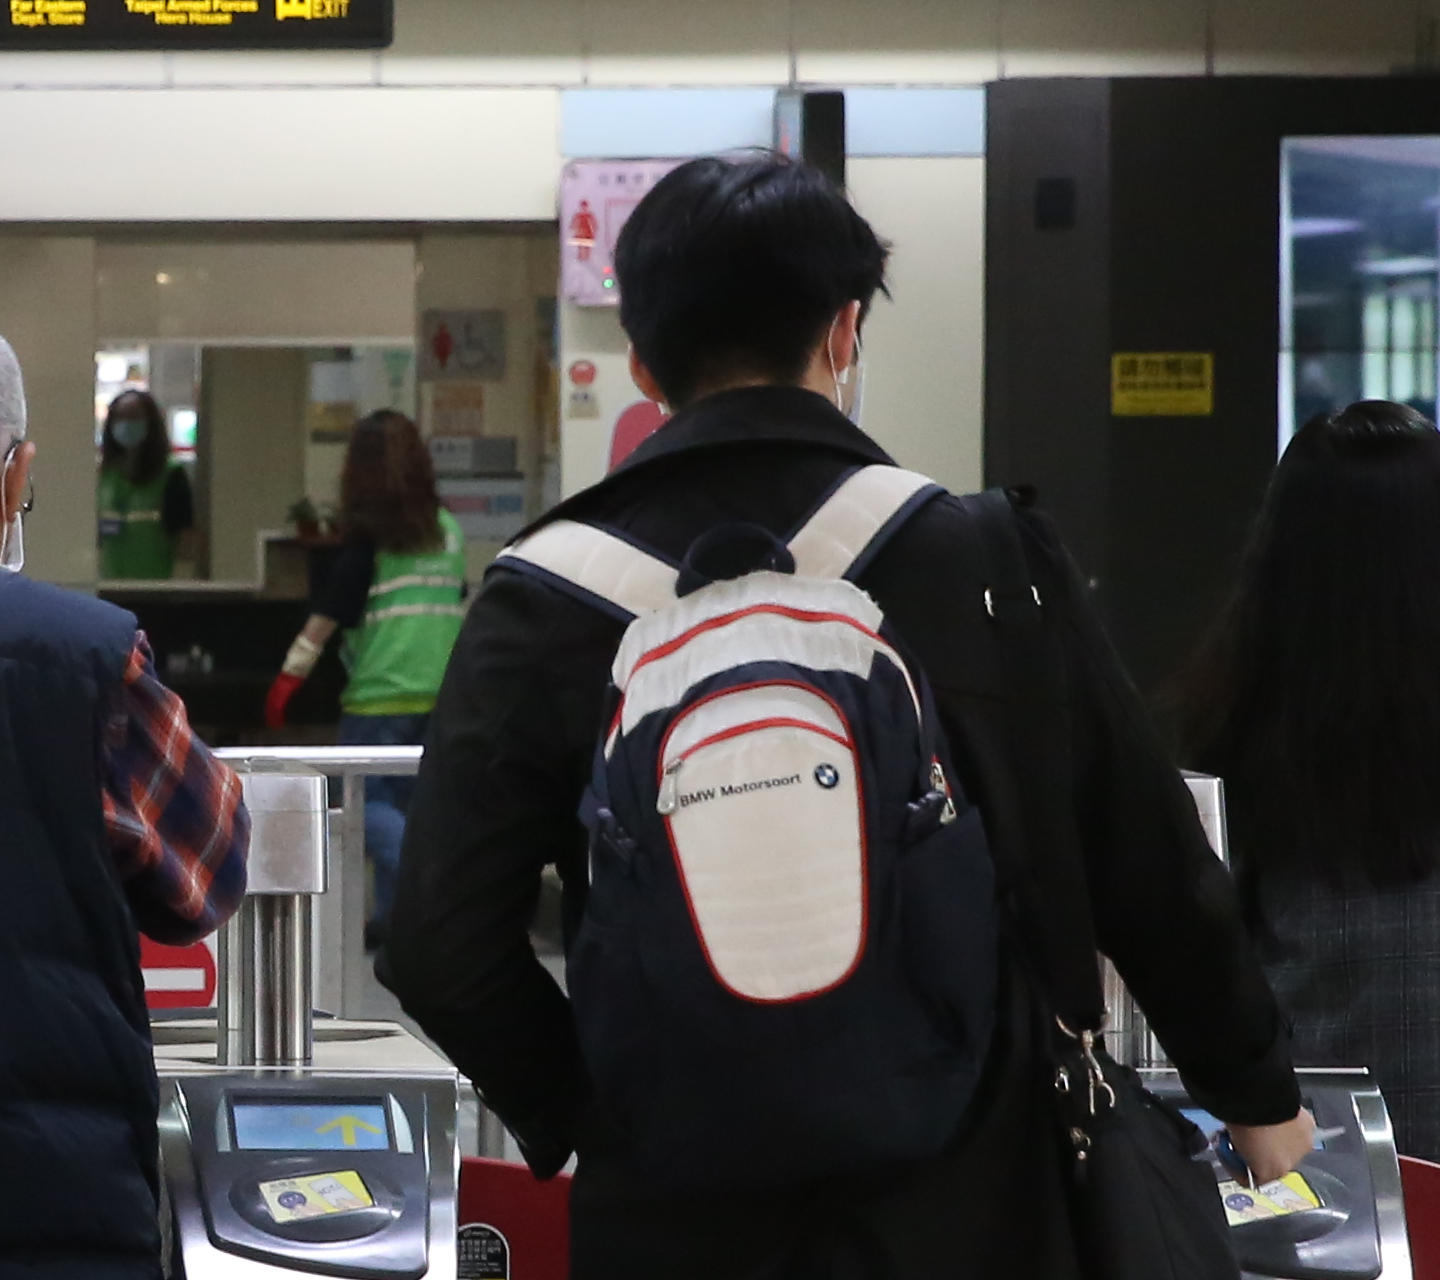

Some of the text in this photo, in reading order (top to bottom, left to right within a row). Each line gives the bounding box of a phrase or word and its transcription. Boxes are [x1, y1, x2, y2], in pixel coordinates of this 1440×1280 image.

[314, 0, 350, 19] EXIT
[679, 773, 802, 808] BMW Motorsport
